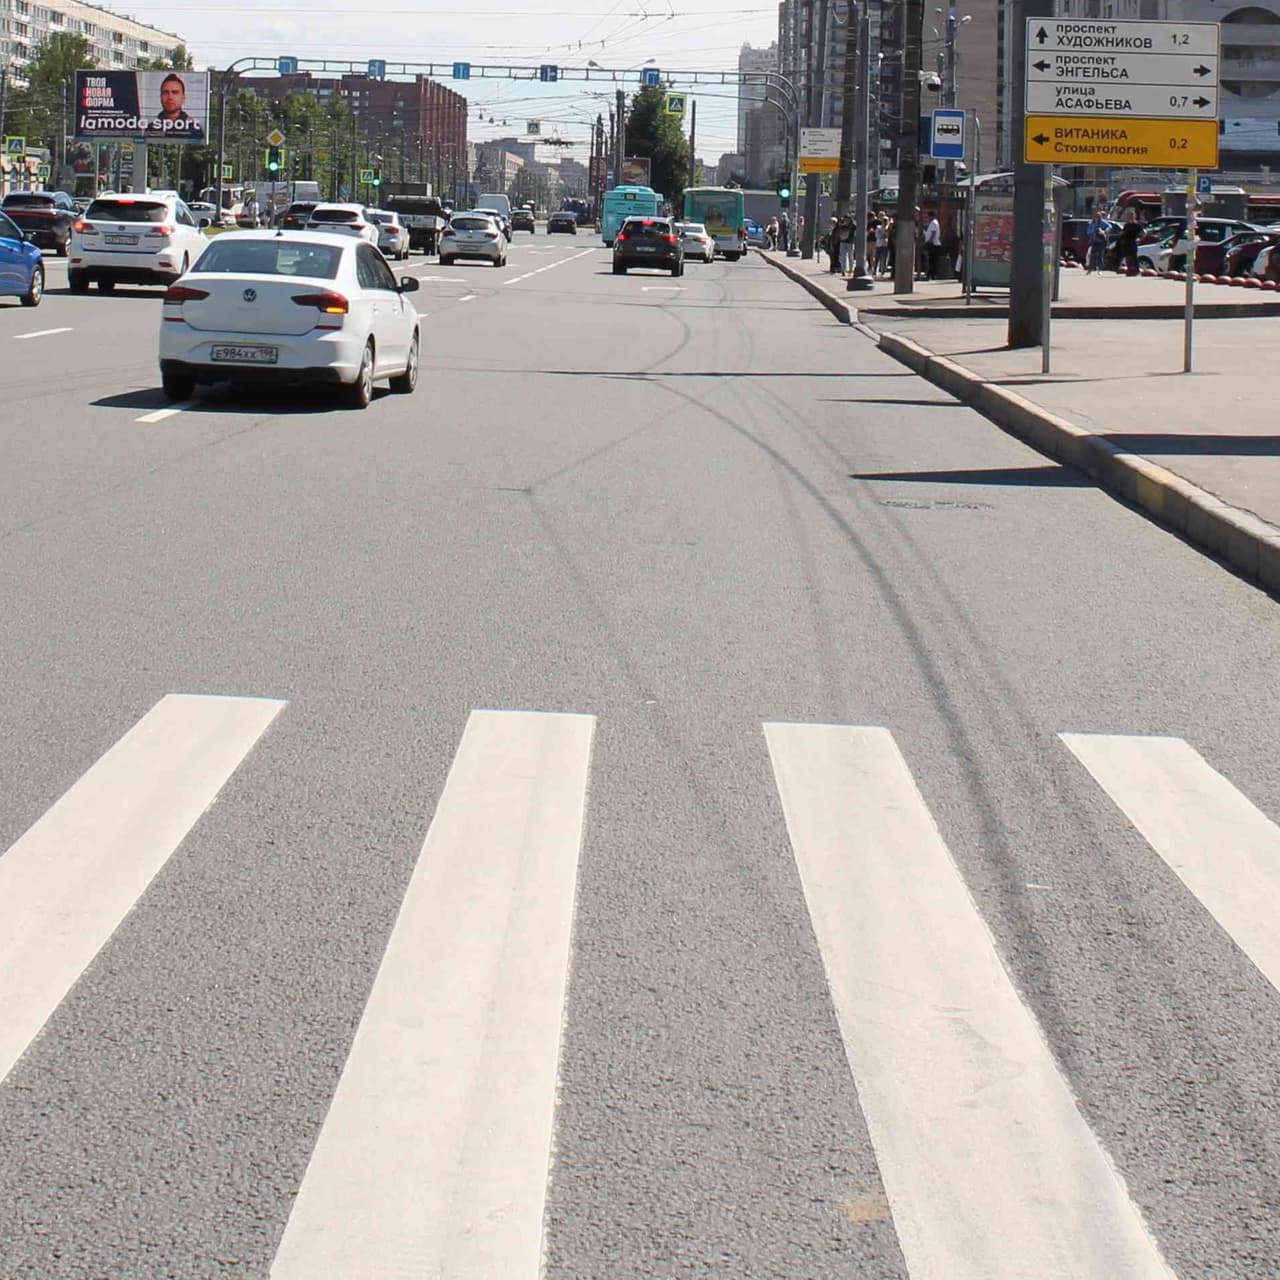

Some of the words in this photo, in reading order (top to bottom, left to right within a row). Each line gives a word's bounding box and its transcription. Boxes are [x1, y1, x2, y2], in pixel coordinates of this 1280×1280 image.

[1056, 24, 1117, 35] проспект
[1056, 36, 1153, 49] ХУДОЖНИКОВ
[1171, 34, 1190, 46] 1,2
[1056, 55, 1116, 66] проспект
[1056, 67, 1129, 79] ЭНГЕЛЬСА
[1056, 86, 1096, 96] улица
[1056, 97, 1132, 110] АСАФЬЕВА
[1170, 96, 1188, 108] 0,7
[80, 115, 149, 130] lamoda
[152, 117, 201, 132] sport
[1055, 127, 1128, 141] ВИТАНИКА
[1054, 142, 1148, 156] Стоматология
